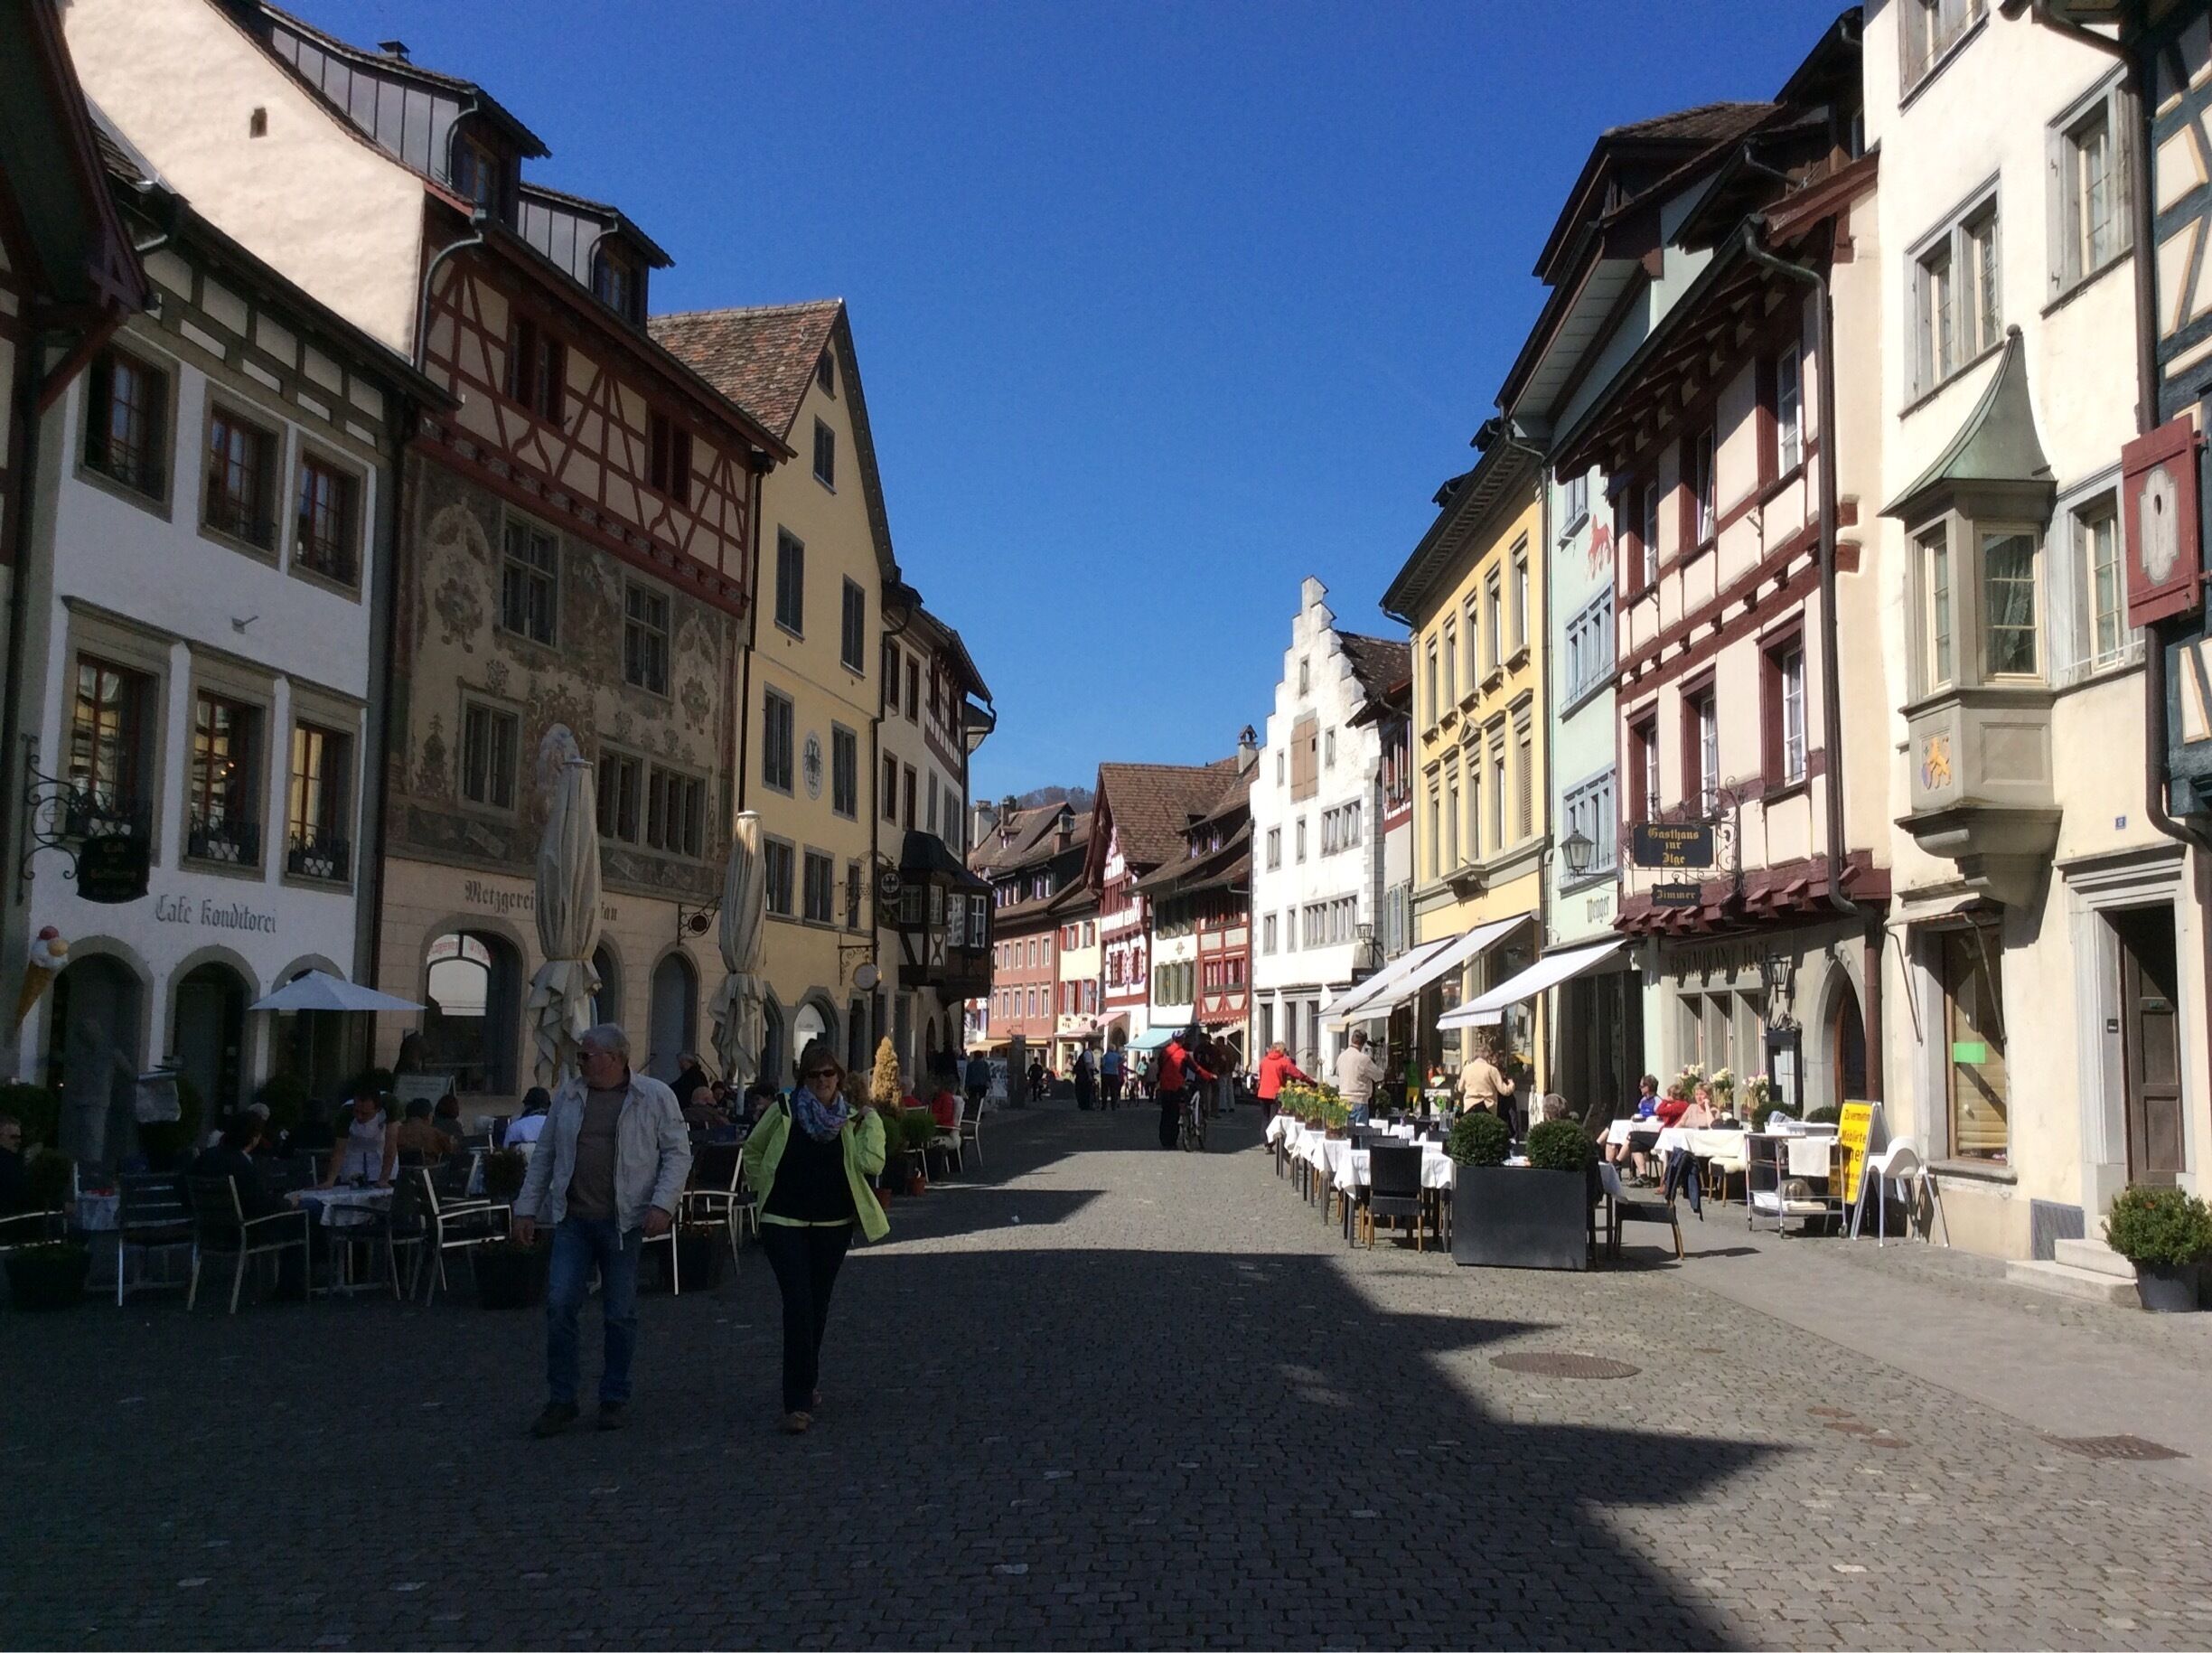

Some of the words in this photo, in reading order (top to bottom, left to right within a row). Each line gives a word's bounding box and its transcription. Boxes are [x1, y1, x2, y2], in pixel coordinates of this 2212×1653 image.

[1647, 827, 1700, 841] Gasthaus
[464, 880, 535, 914] Metzgerei
[1656, 890, 1696, 901] Zimmer
[201, 898, 276, 934] Konditorei
